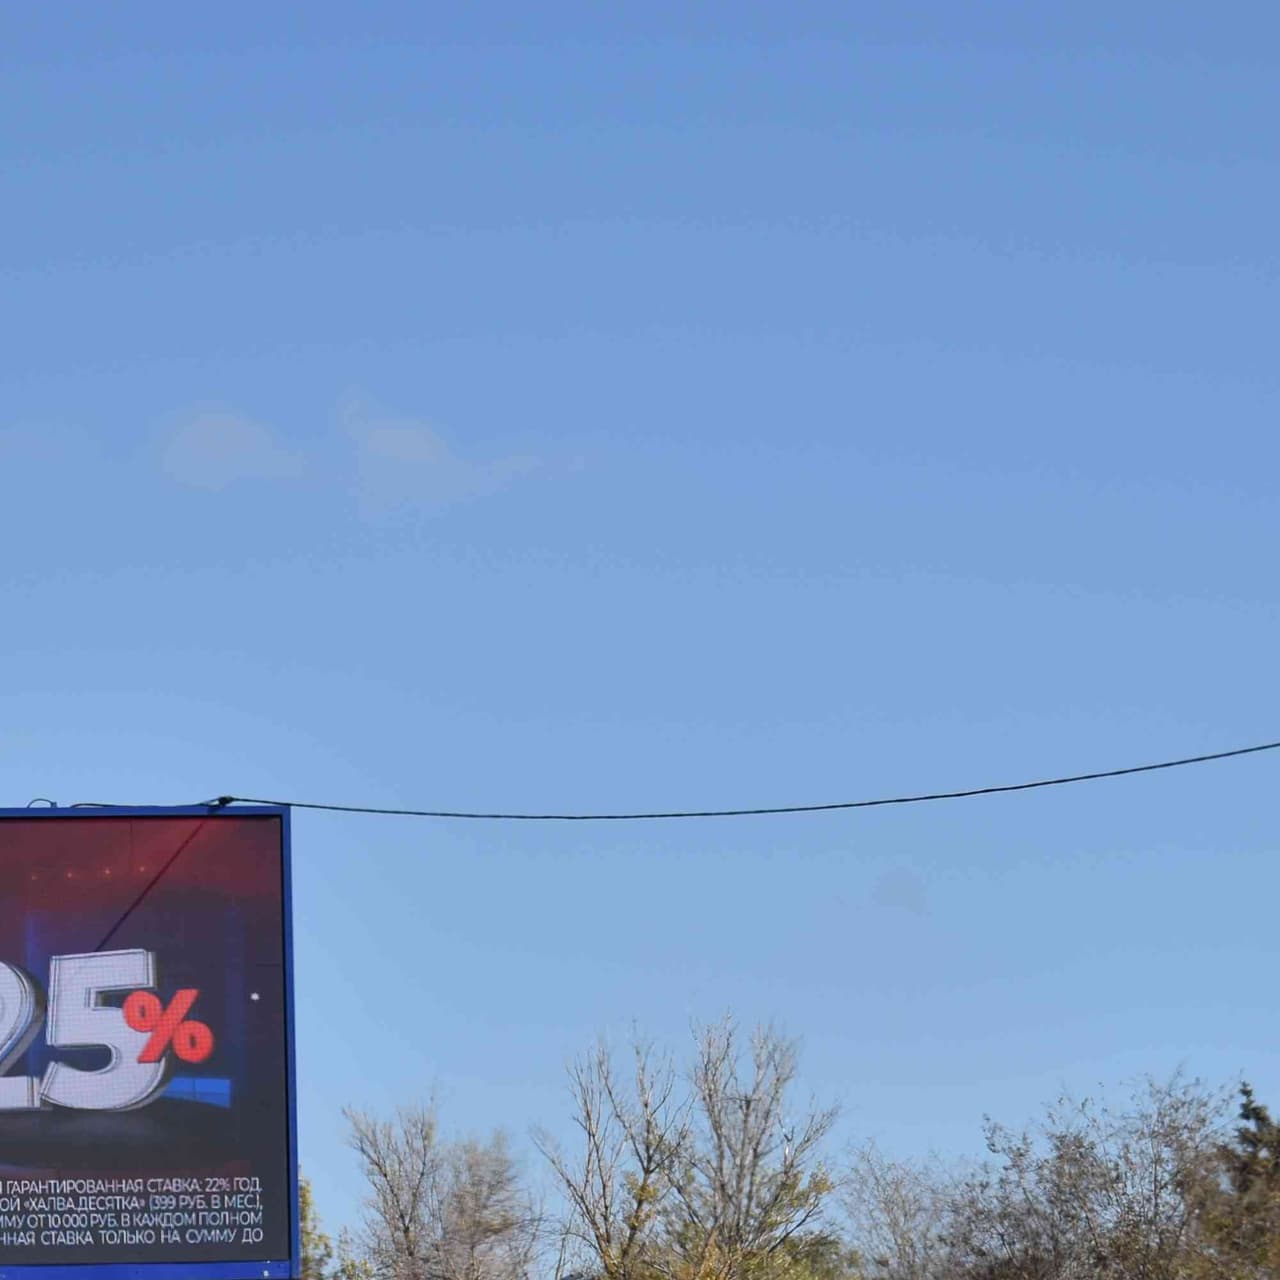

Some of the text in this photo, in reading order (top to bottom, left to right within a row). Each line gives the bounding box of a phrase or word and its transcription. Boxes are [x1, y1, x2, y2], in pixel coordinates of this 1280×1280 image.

[7, 1179, 144, 1194] ГАРАНТИРОВАННАЯ
[146, 1178, 203, 1193] СТАВКА:
[205, 1178, 230, 1192] 22%
[148, 1195, 176, 1211] (399
[179, 1195, 208, 1211] РУБ.
[211, 1195, 221, 1209] В
[27, 1214, 47, 1228] ОТ
[48, 1214, 60, 1228] 10
[61, 1213, 87, 1227] 000
[90, 1213, 119, 1228] РУБ.
[121, 1213, 131, 1226] В
[133, 1211, 196, 1228] КАЖДОМ
[198, 1211, 262, 1226] ПОЛНОМ
[40, 1230, 94, 1246] СТАВКА
[99, 1229, 156, 1245] ТОЛЬКО
[161, 1229, 180, 1244] НА
[185, 1228, 237, 1244] СУММУ
[242, 1227, 264, 1243] ДО
